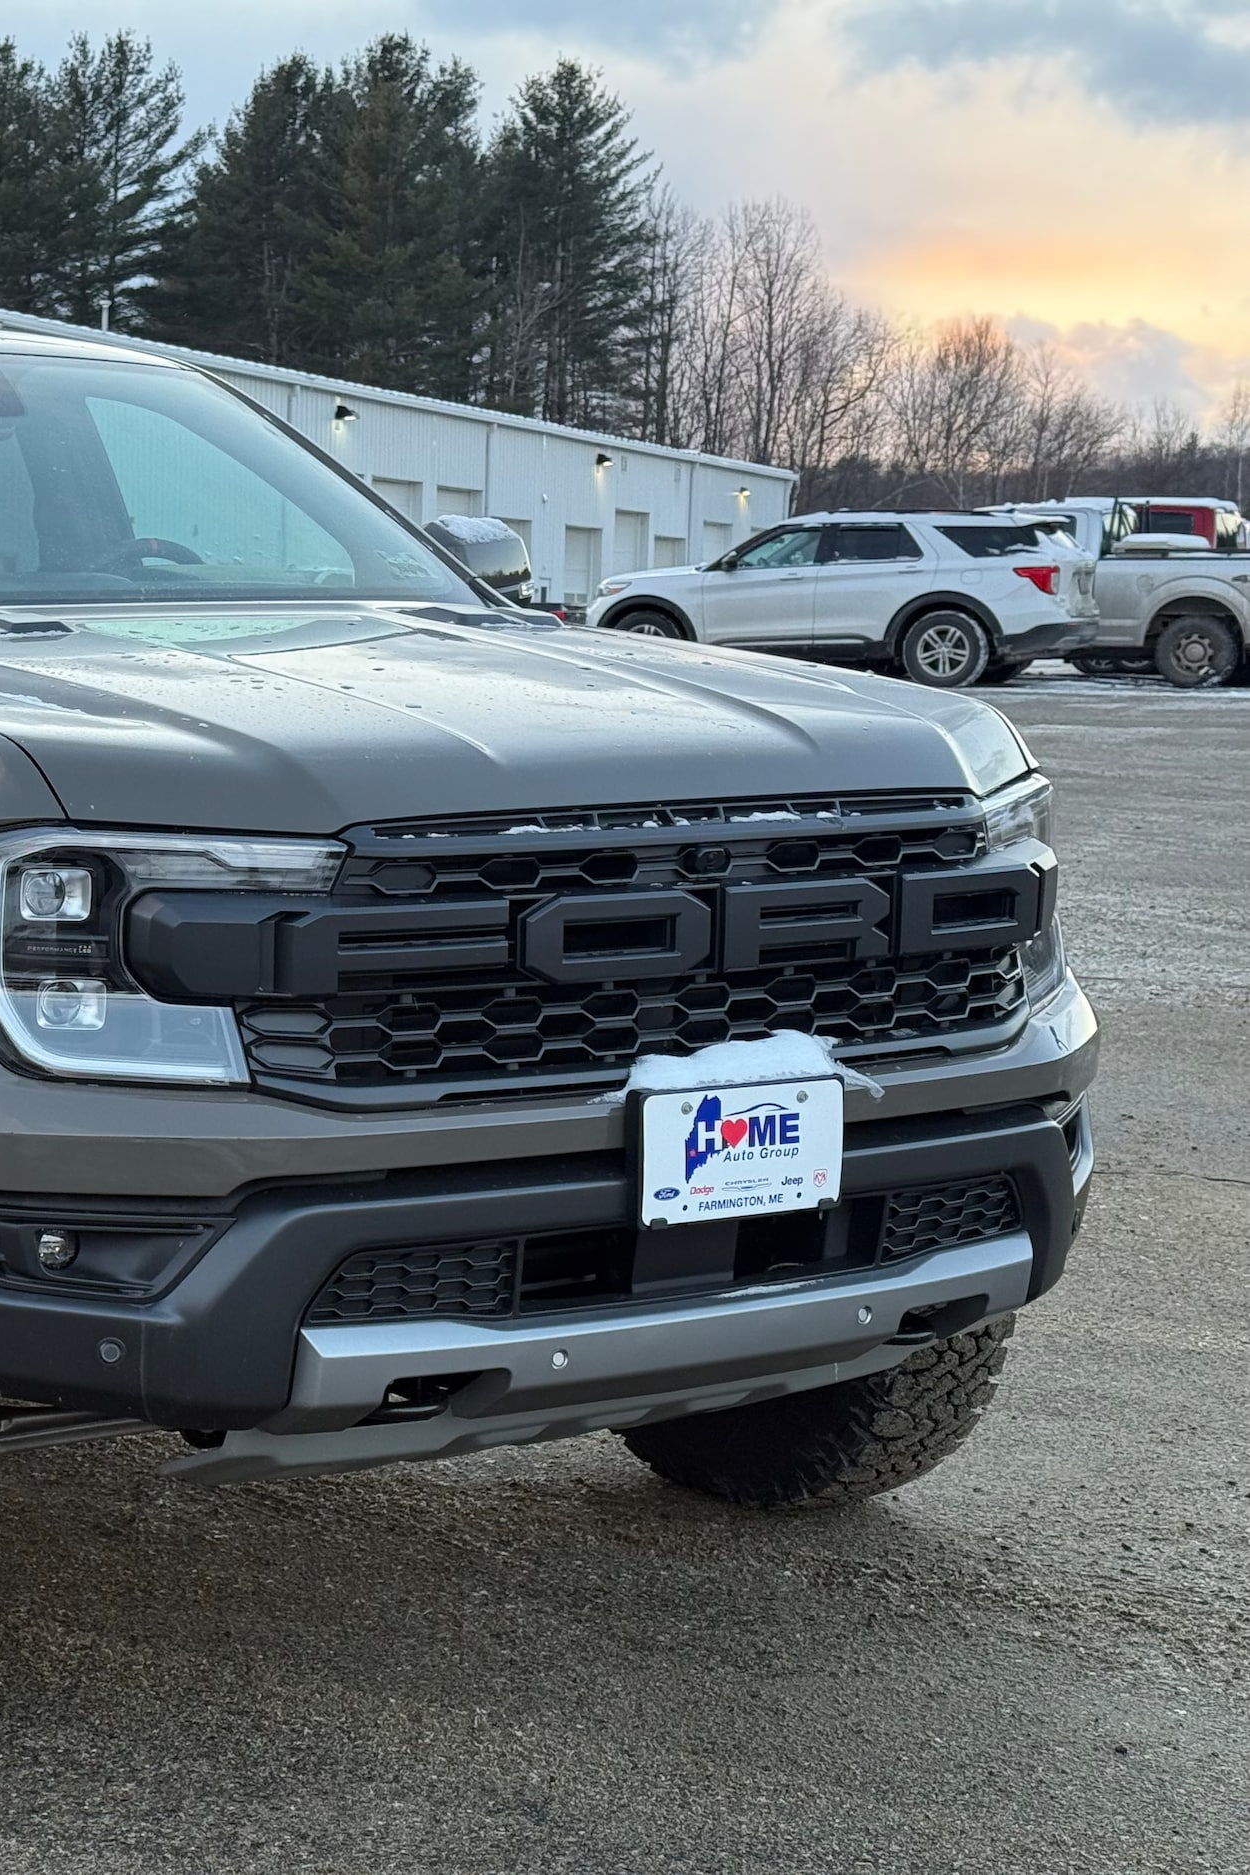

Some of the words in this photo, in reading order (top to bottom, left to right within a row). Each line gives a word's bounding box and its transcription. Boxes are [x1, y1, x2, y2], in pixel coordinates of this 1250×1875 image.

[263, 860, 1042, 996] FORD
[723, 1150, 754, 1163] Auto
[760, 1146, 799, 1160] Group
[690, 1185, 715, 1196] Dodge
[724, 1177, 769, 1186] CHRYSLER
[781, 1175, 804, 1187] Jeep
[698, 1196, 765, 1212] FARMINGTON,
[768, 1193, 784, 1204] ME
